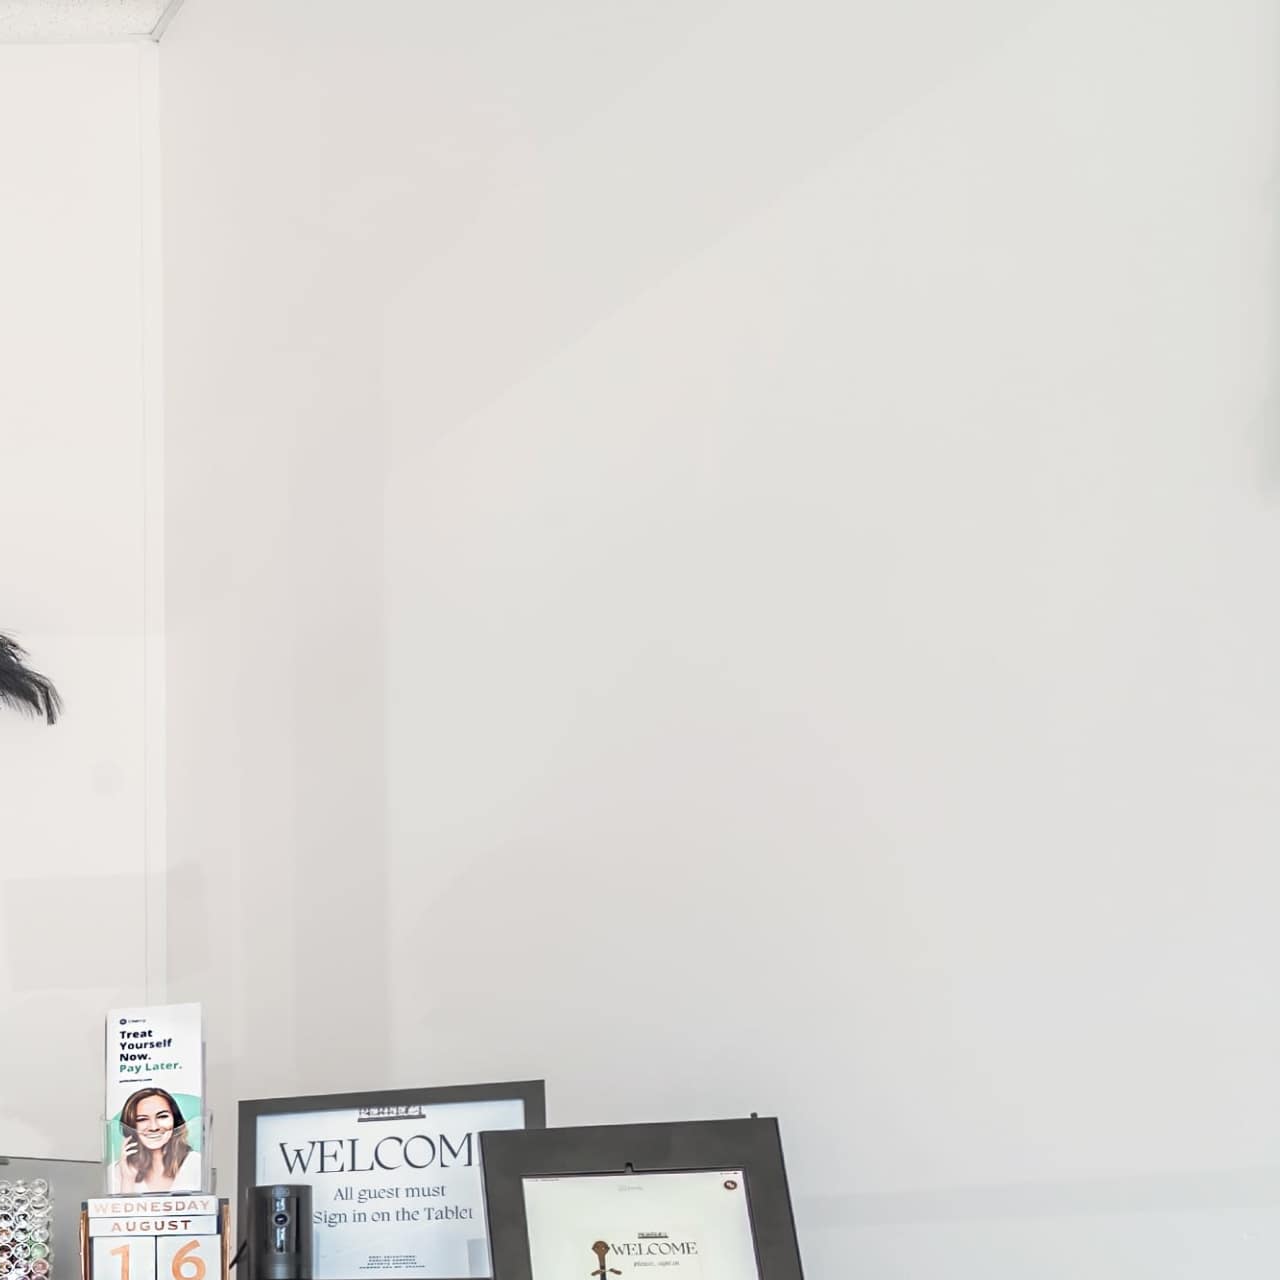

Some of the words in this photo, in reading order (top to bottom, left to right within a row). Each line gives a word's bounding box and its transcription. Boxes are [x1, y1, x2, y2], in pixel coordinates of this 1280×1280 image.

[120, 1030, 153, 1039] Treat
[120, 1038, 172, 1050] Yourself
[120, 1053, 152, 1062] Now.
[120, 1064, 142, 1074] Pay
[145, 1062, 183, 1071] Later.
[279, 1132, 473, 1175] WELCOM
[333, 1187, 353, 1201] All
[357, 1186, 400, 1203] guest
[404, 1184, 446, 1198] must
[94, 1200, 210, 1214] WEDNESDAY
[312, 1210, 347, 1228] Sign
[352, 1208, 367, 1222] in
[370, 1210, 390, 1222] on
[395, 1206, 420, 1221] the
[111, 1220, 192, 1233] AUGUST
[611, 1241, 698, 1256] WELCOME
